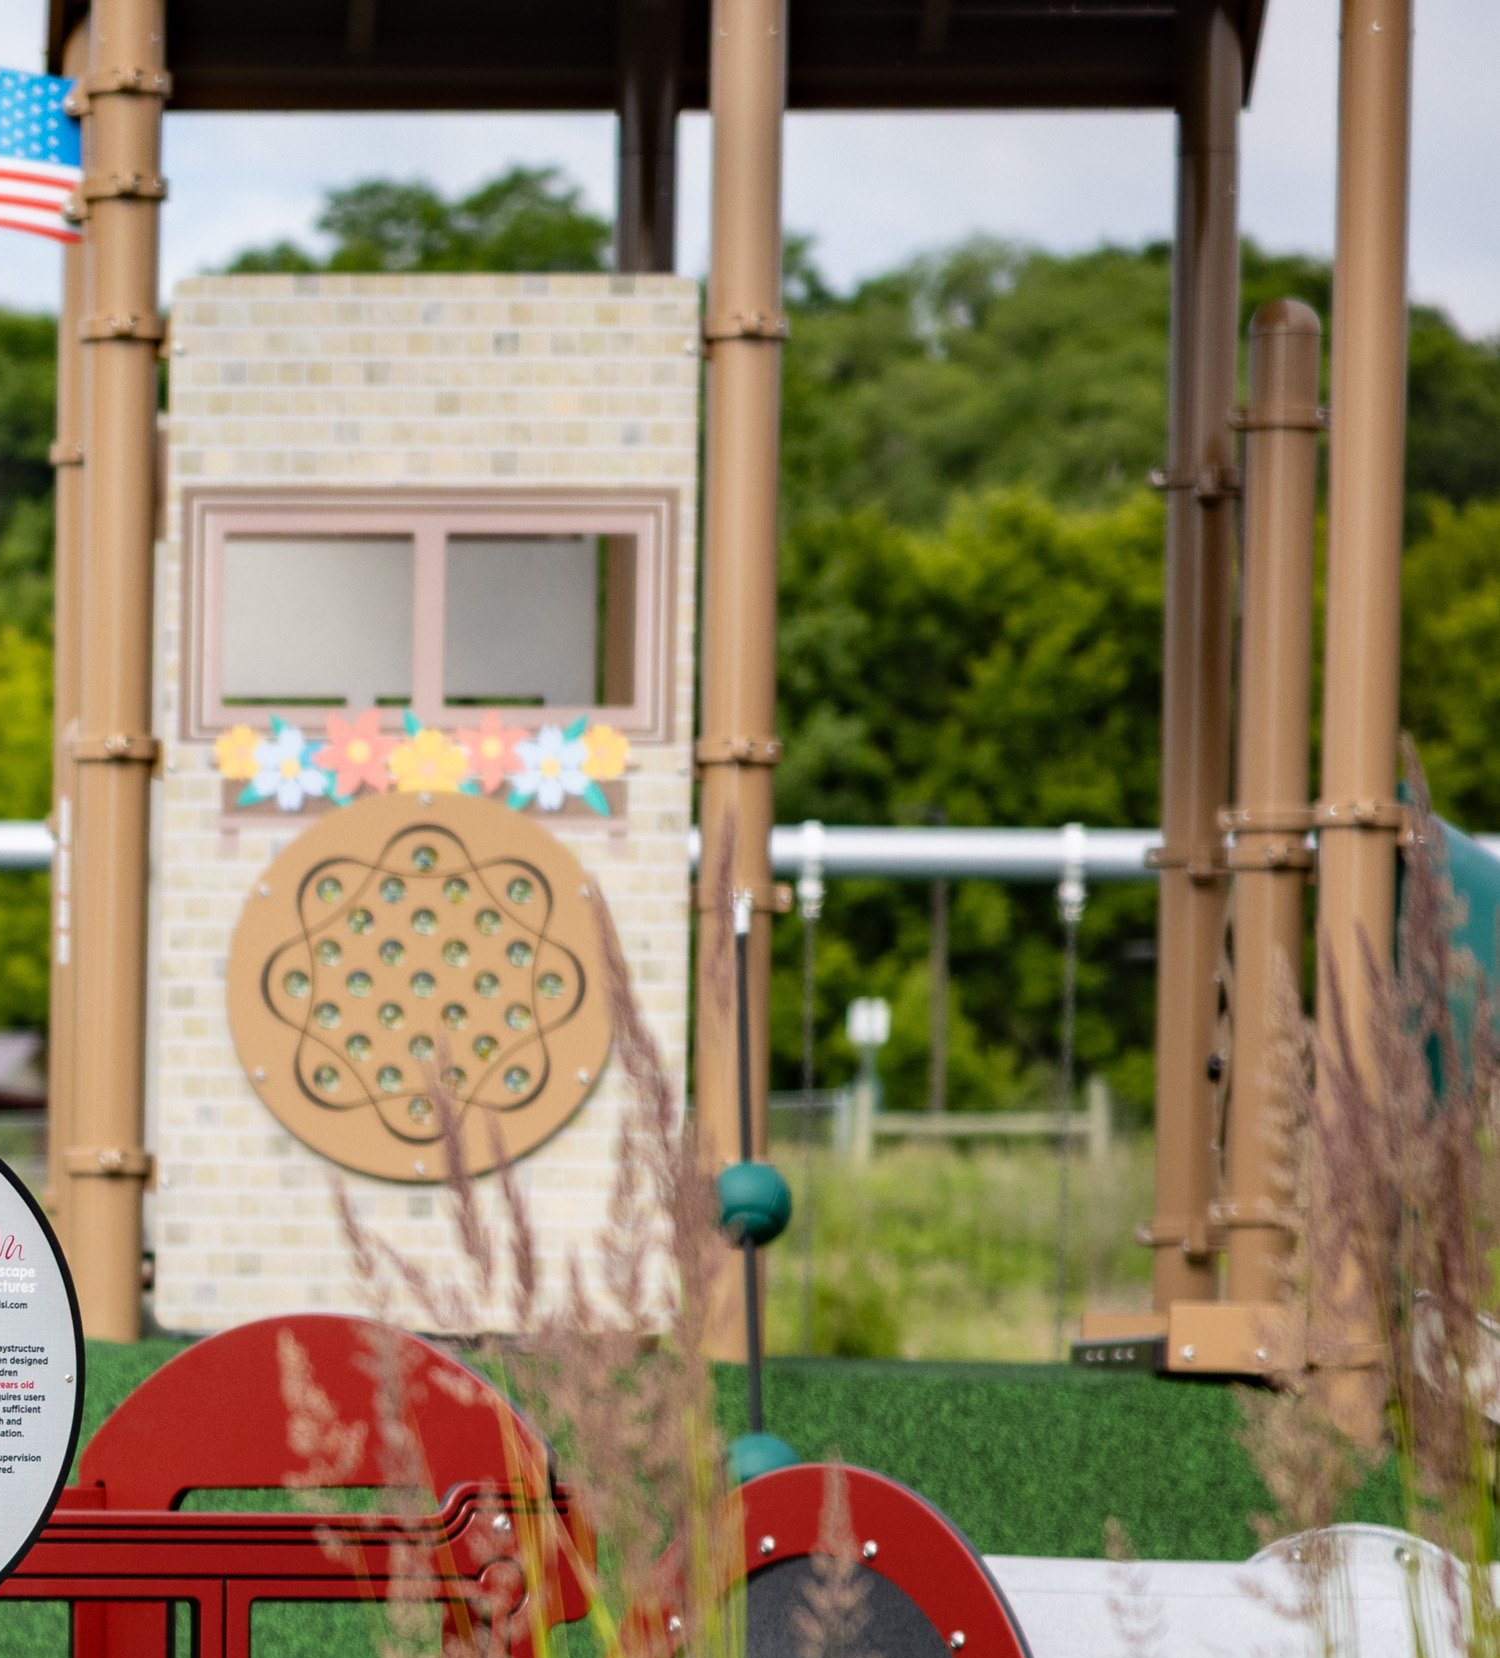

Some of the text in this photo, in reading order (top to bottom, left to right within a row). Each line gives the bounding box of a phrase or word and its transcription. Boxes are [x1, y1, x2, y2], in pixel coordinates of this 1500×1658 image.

[9, 1356, 49, 1366] designed
[20, 1381, 34, 1389] old
[2, 1405, 42, 1414] sufficient
[6, 1417, 22, 1426] and
